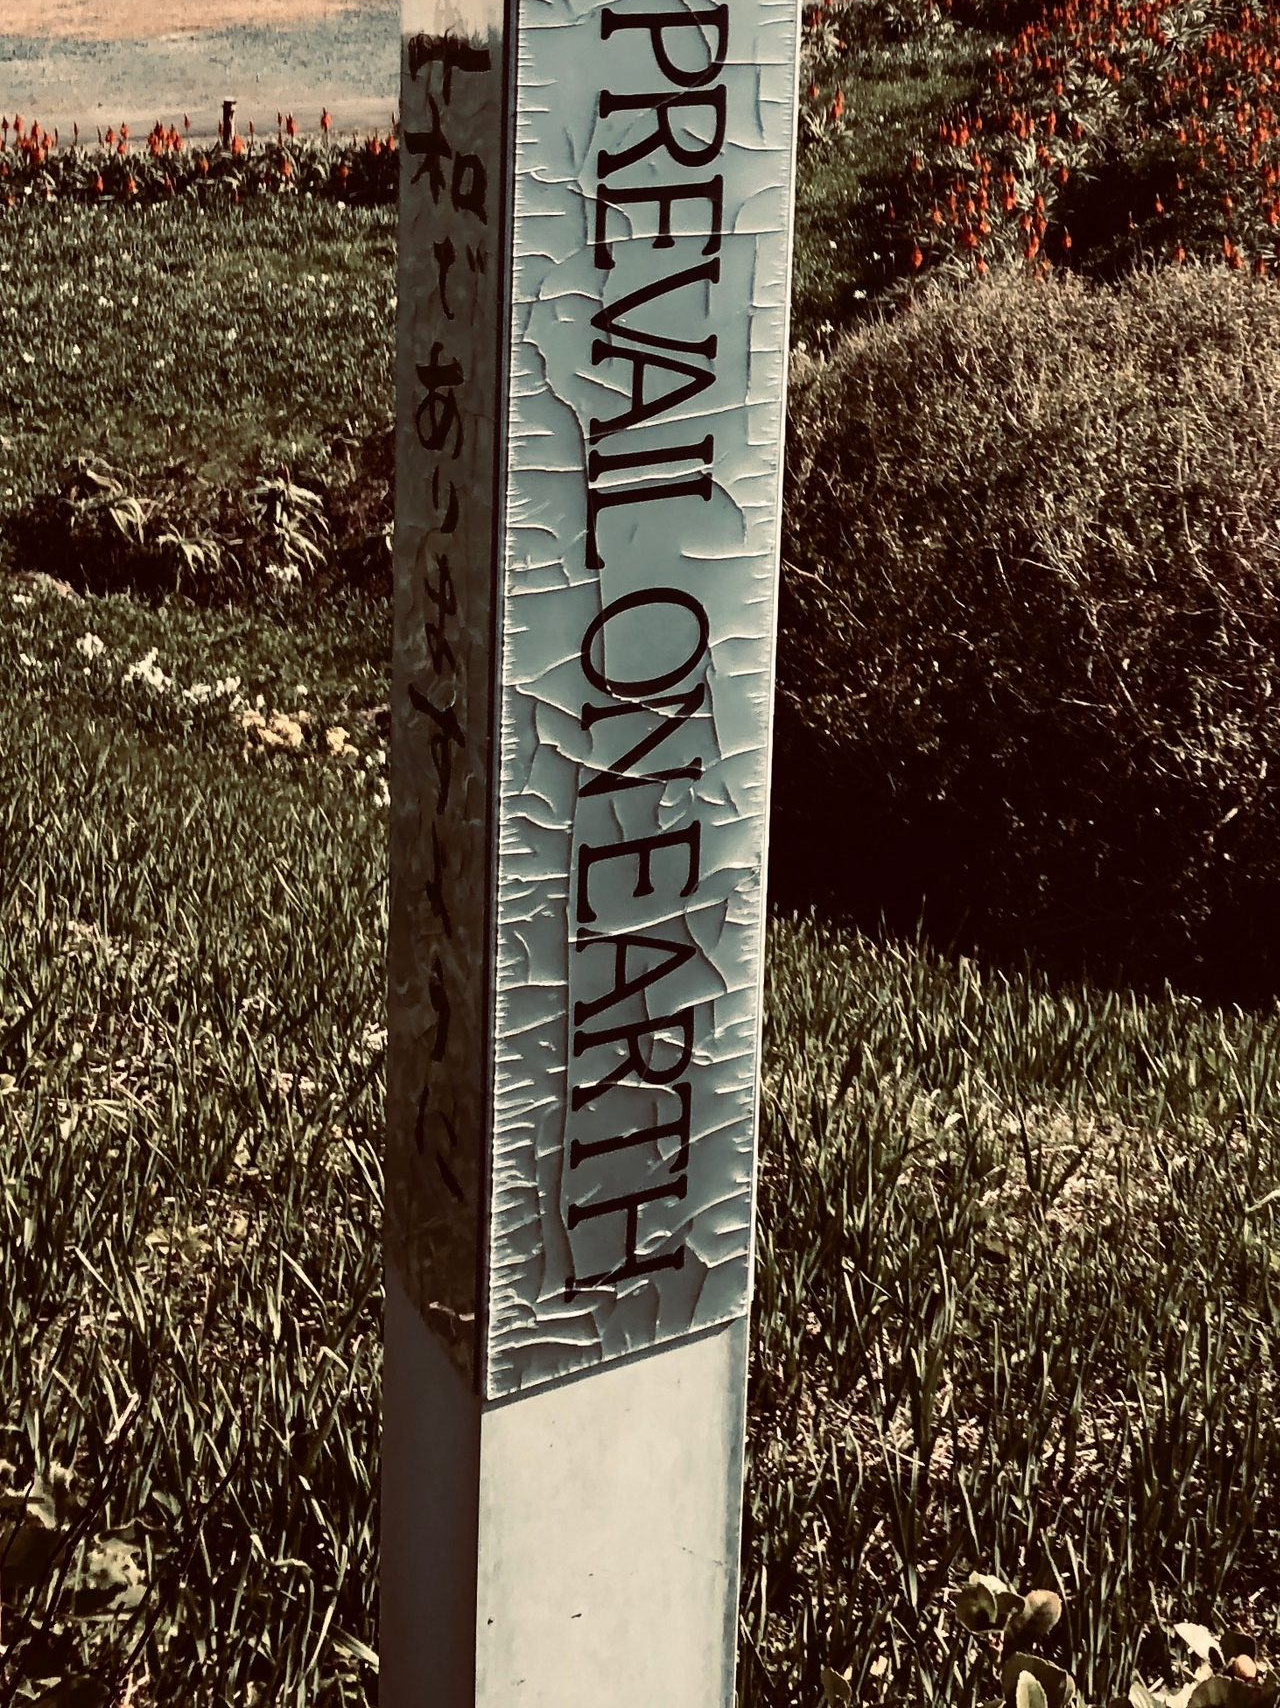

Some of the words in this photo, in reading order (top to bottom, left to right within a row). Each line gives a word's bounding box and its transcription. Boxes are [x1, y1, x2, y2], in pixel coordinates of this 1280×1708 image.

[585, 2, 730, 571] PREVAIL
[579, 586, 710, 798] ON
[563, 819, 701, 1304] EARTH
